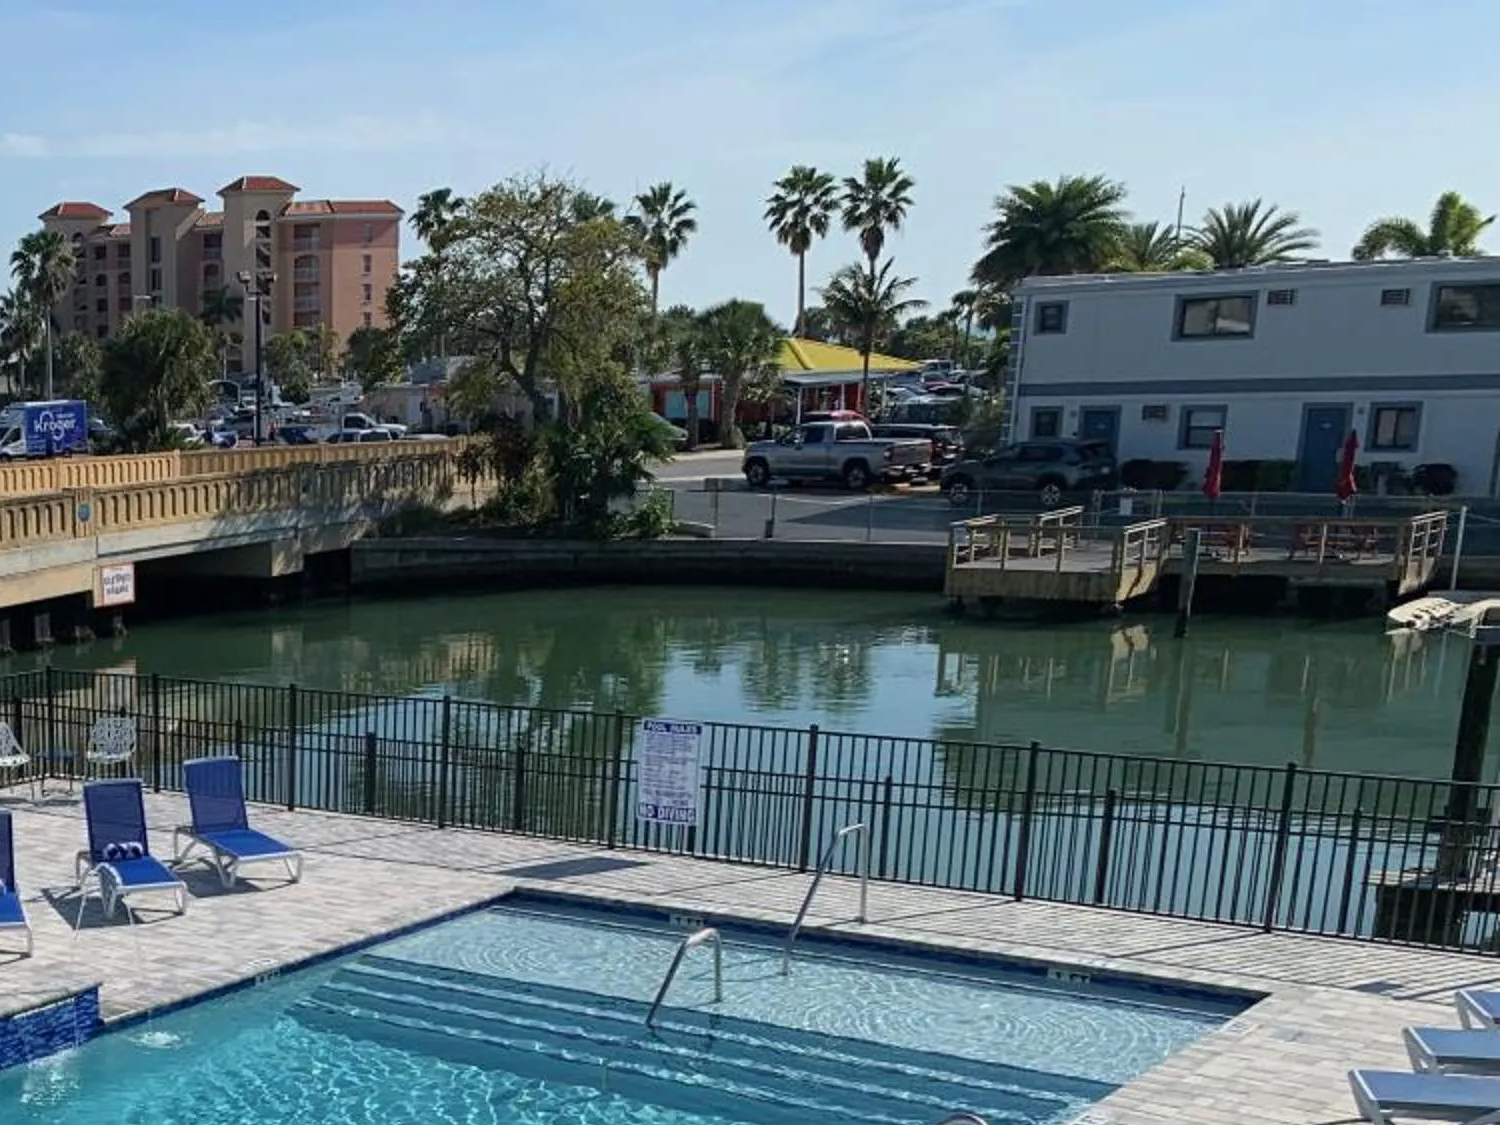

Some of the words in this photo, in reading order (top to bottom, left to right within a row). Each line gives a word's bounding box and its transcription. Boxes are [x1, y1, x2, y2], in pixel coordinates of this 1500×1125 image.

[33, 411, 77, 441] Kroger
[639, 803, 655, 819] NO
[657, 807, 696, 822] DIVING
